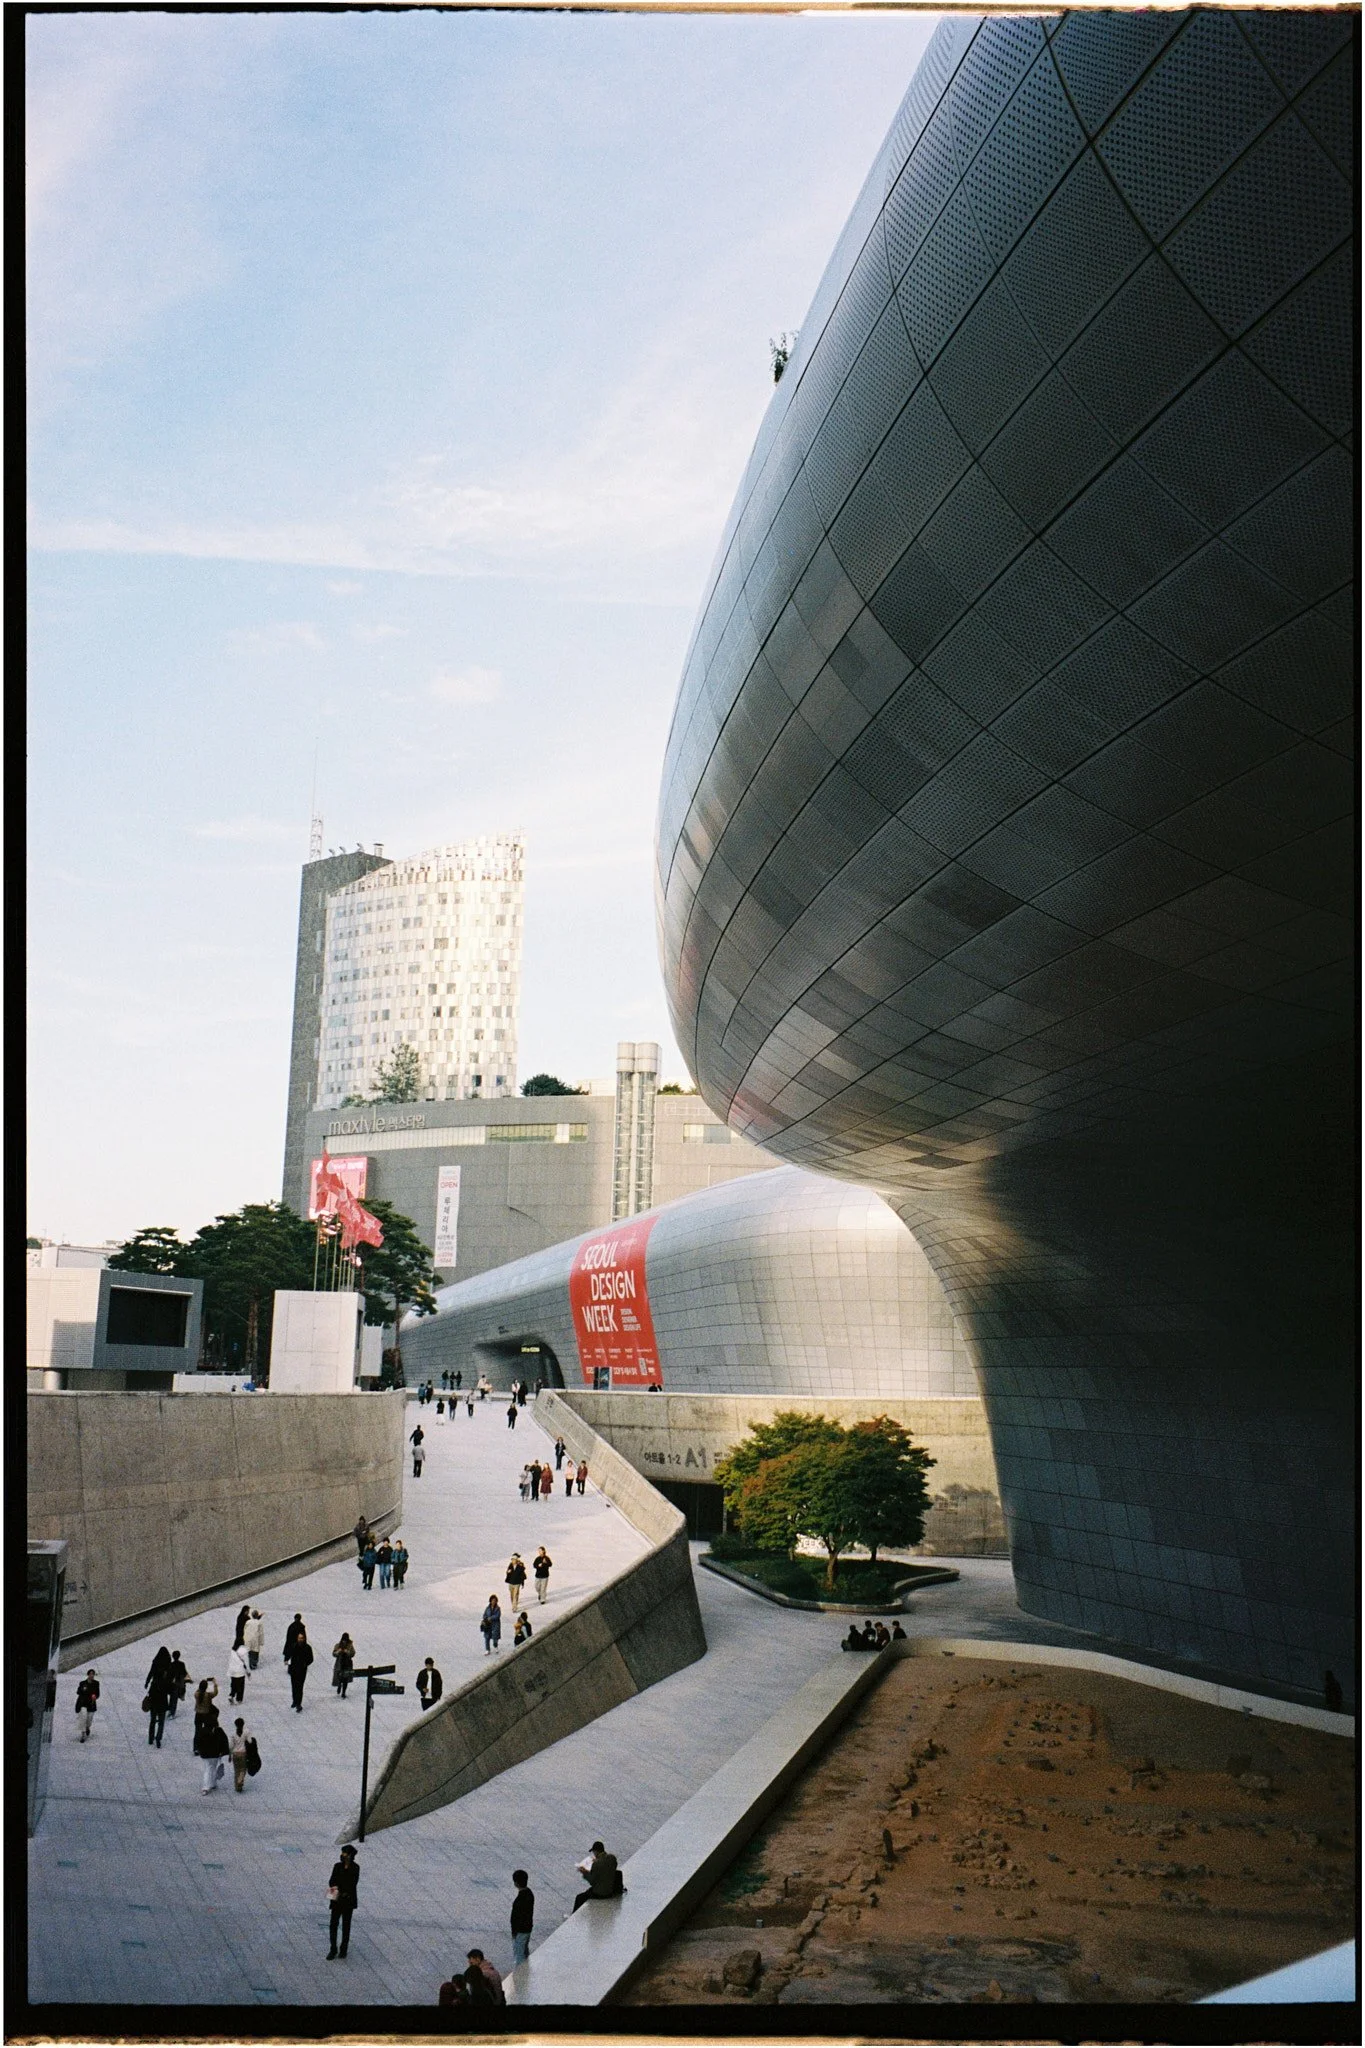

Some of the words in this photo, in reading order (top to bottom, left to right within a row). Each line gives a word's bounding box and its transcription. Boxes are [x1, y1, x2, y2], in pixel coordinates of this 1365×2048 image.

[580, 1241, 618, 1271] SEOUL
[591, 1270, 636, 1301] DESIGN
[581, 1304, 618, 1333] WEEK
[685, 1447, 707, 1469] A1
